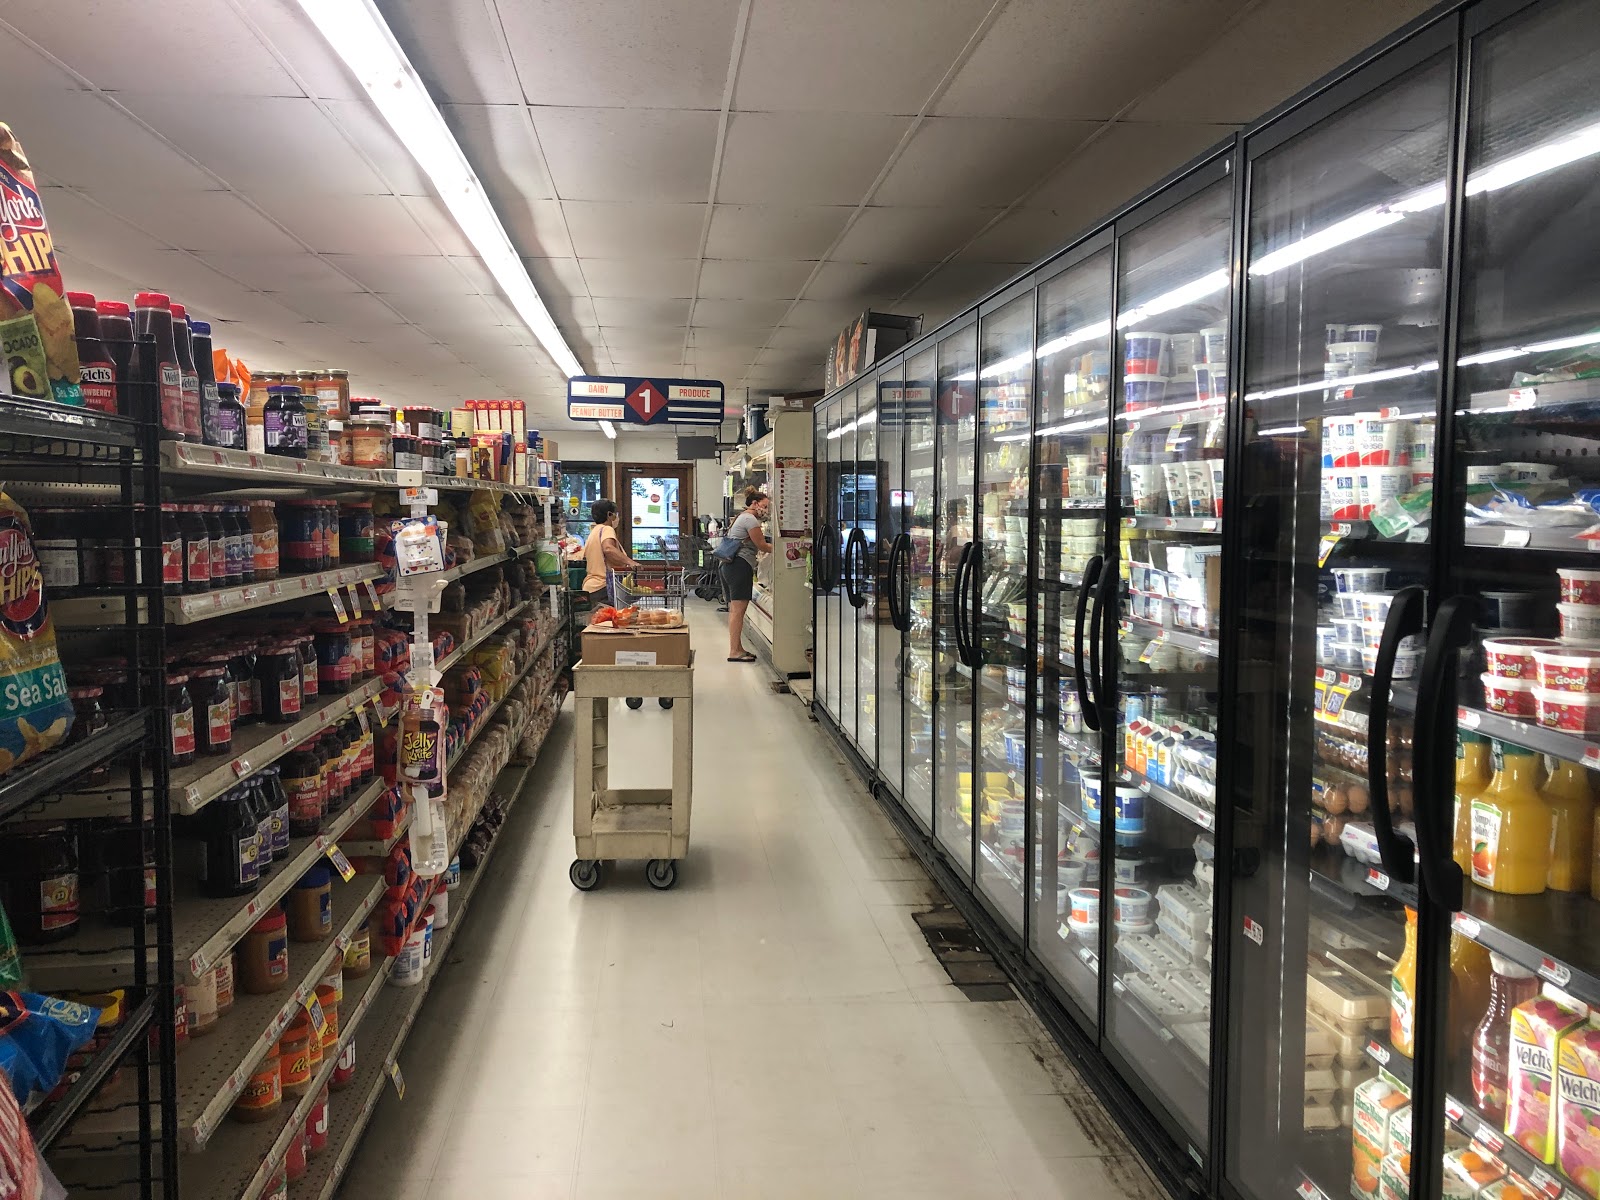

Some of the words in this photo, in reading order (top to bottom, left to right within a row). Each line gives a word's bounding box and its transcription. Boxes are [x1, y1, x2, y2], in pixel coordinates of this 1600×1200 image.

[81, 369, 110, 380] elch's
[68, 385, 79, 397] Sal
[589, 385, 609, 393] DAIRY
[680, 389, 711, 398] PRODUCE
[639, 389, 651, 413] 1
[571, 407, 596, 417] PEANUT
[598, 408, 623, 418] BUTTER
[1496, 662, 1522, 672] Good!
[1554, 675, 1589, 685] Good!
[5, 683, 42, 711] Sea
[404, 732, 435, 751] Jelly
[407, 747, 433, 762] Knife
[1560, 1074, 1600, 1103] Welch'
